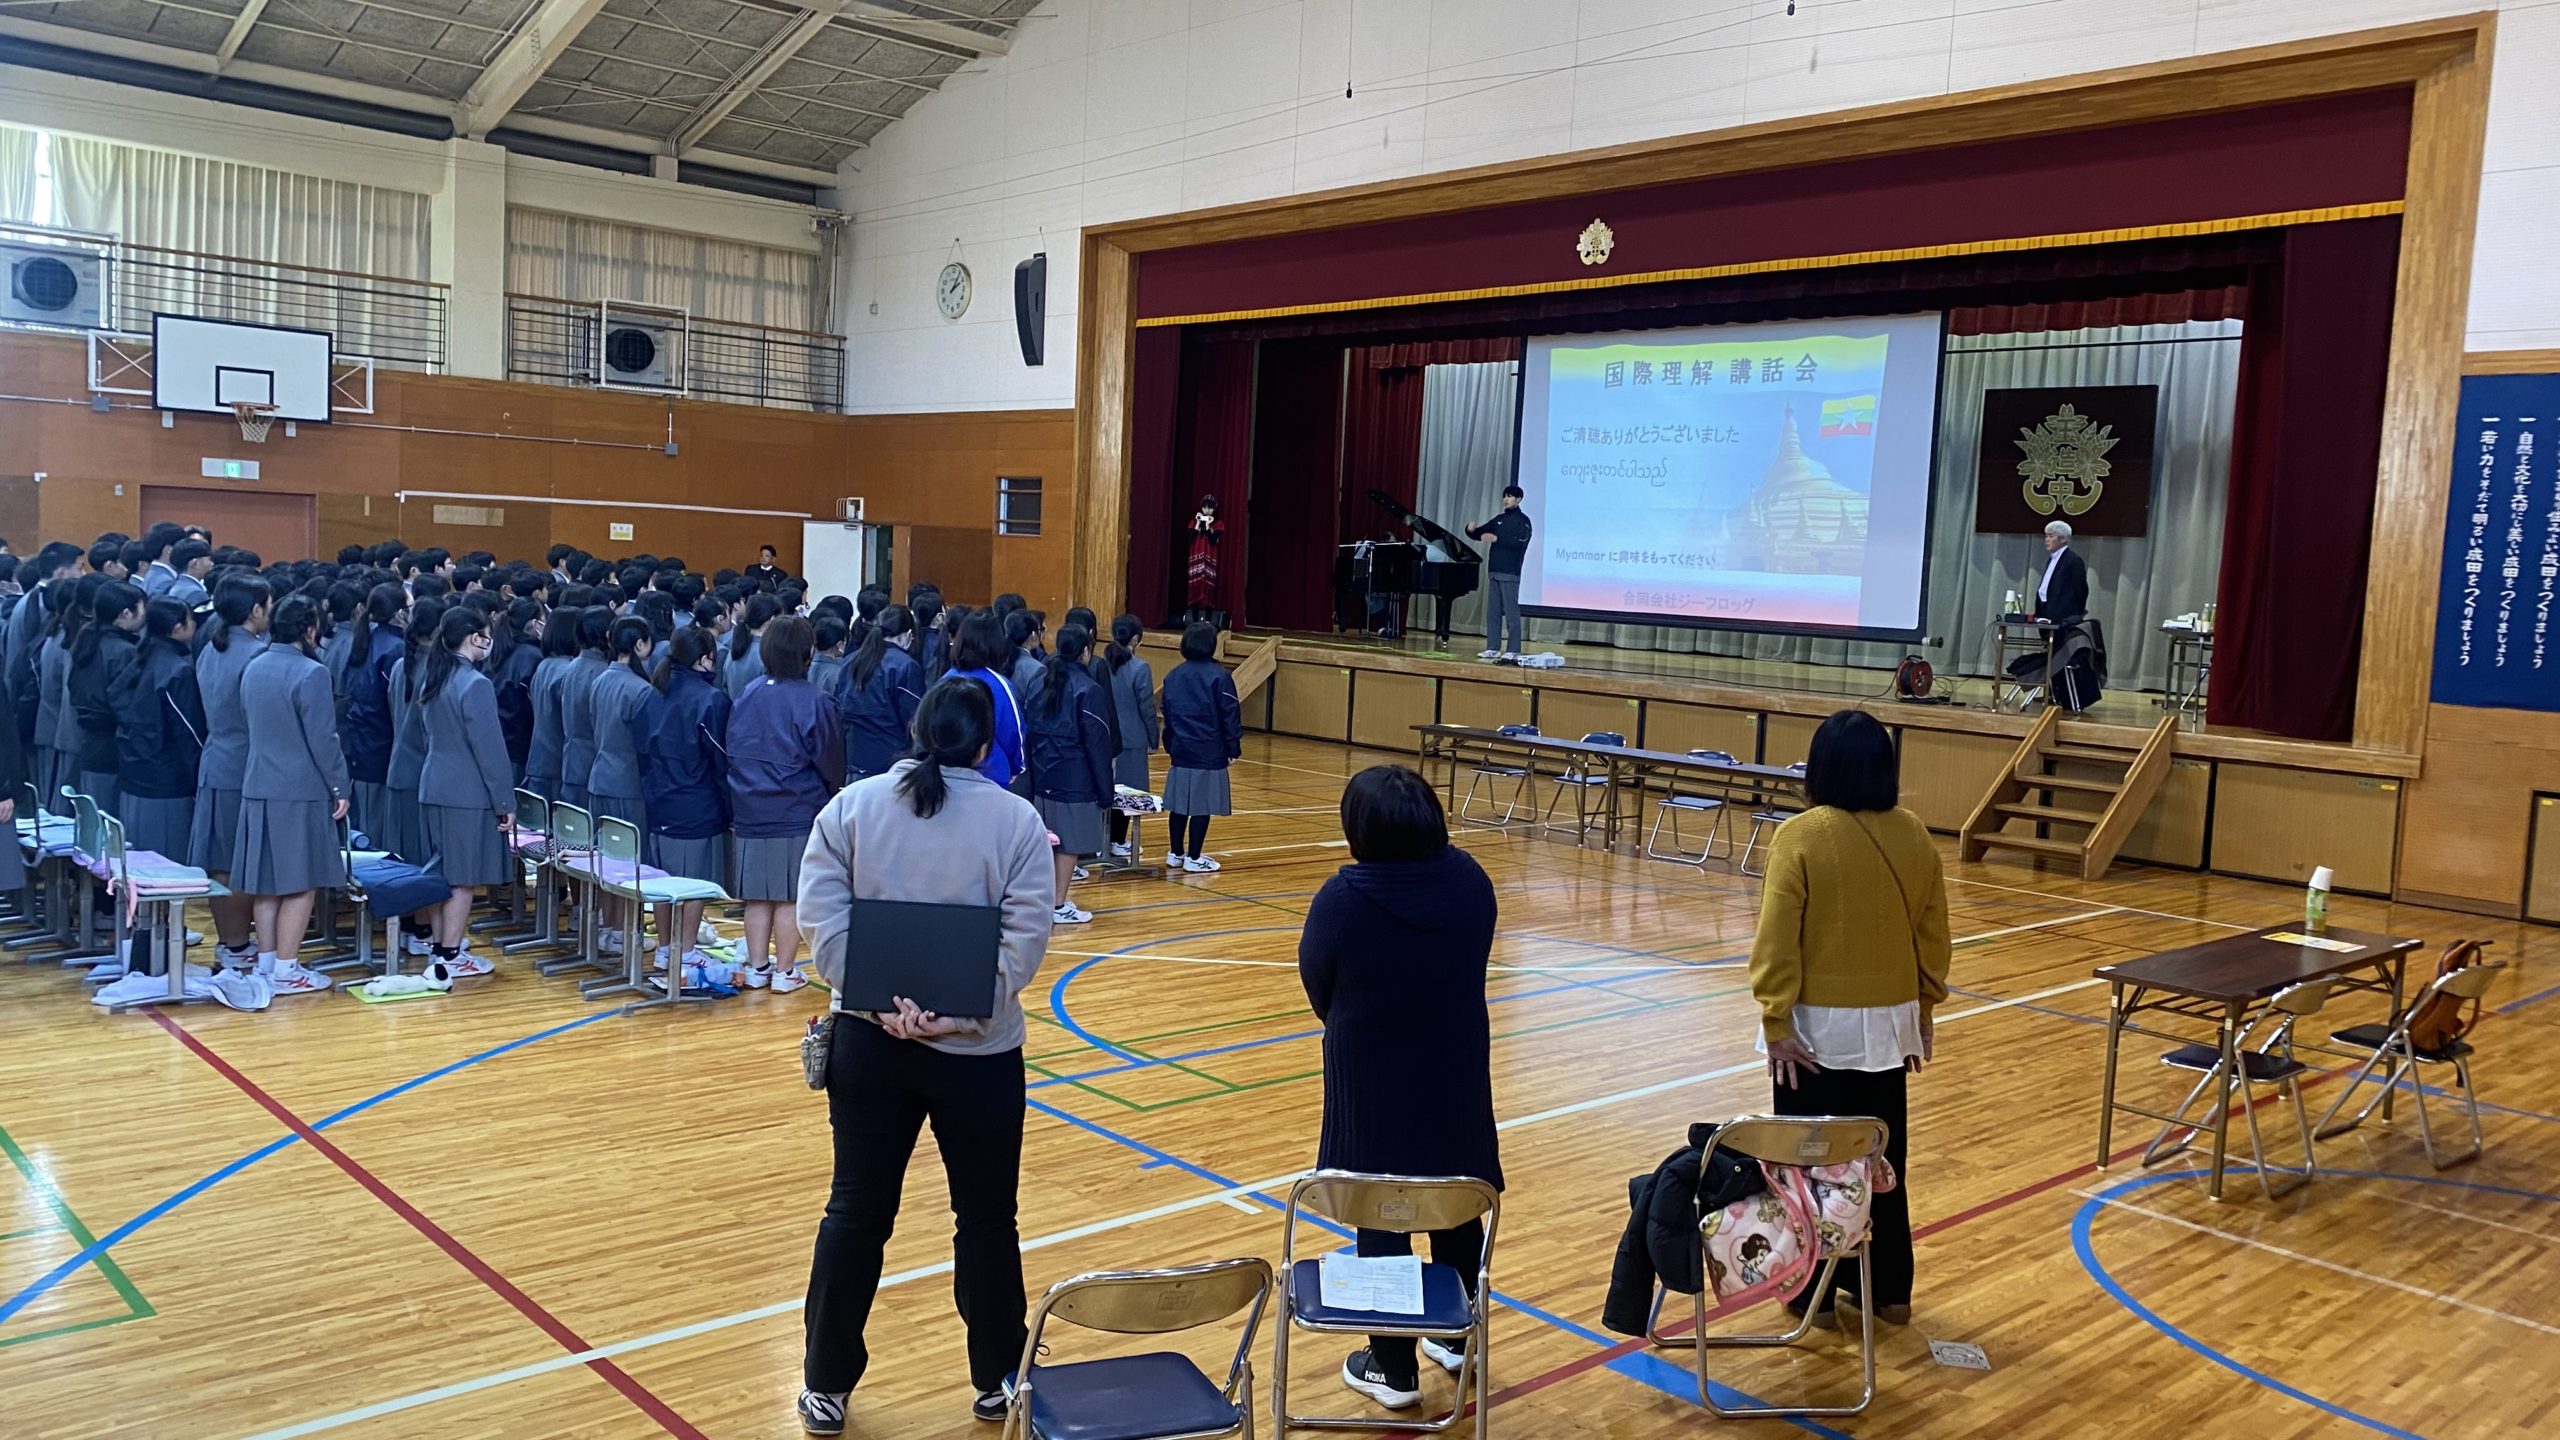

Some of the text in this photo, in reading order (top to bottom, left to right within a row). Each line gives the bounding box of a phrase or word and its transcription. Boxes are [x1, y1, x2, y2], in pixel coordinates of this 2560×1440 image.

[1604, 353, 1819, 389] 国際理解 講話会
[1561, 424, 1740, 446] ご清聴ありがとうございました
[1555, 548, 1716, 567] Myanmar に興味をもってください
[1623, 590, 1756, 614] 合同会社ジーフロッグ
[1365, 1370, 1386, 1383] HOKA
